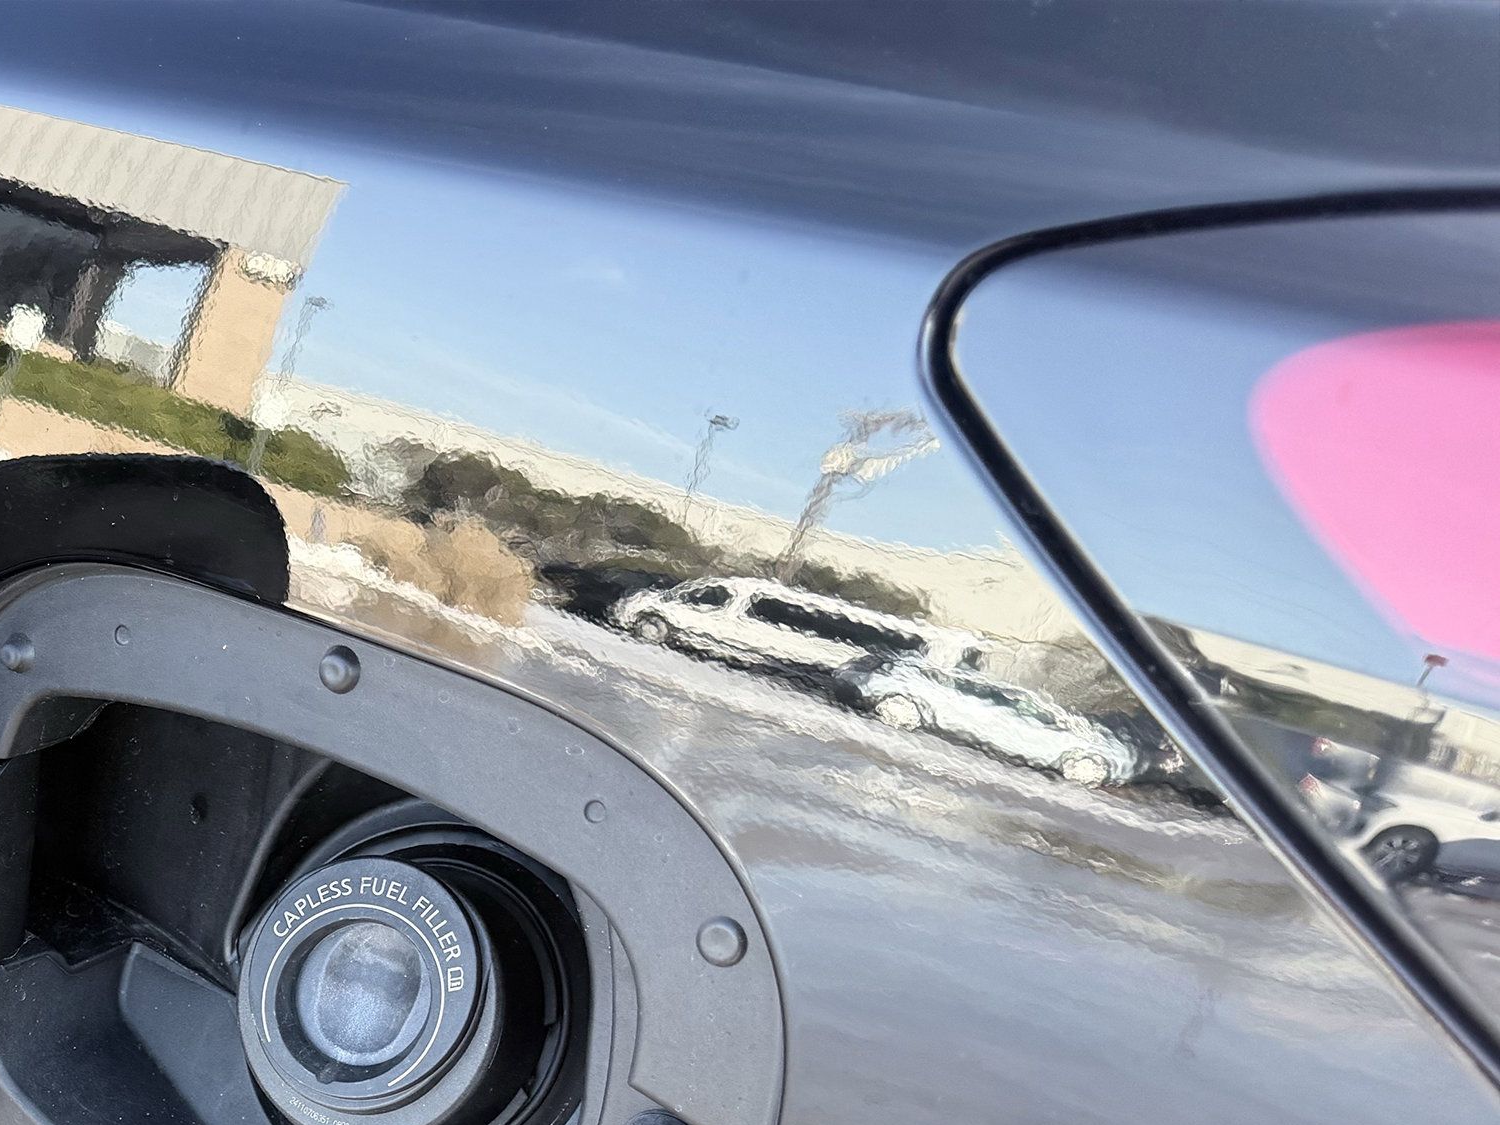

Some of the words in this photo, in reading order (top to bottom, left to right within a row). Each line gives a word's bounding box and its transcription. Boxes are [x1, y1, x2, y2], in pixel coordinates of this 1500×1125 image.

[273, 878, 352, 938] CAPLESS
[359, 876, 408, 905] FUEL
[411, 896, 462, 962] FILLER
